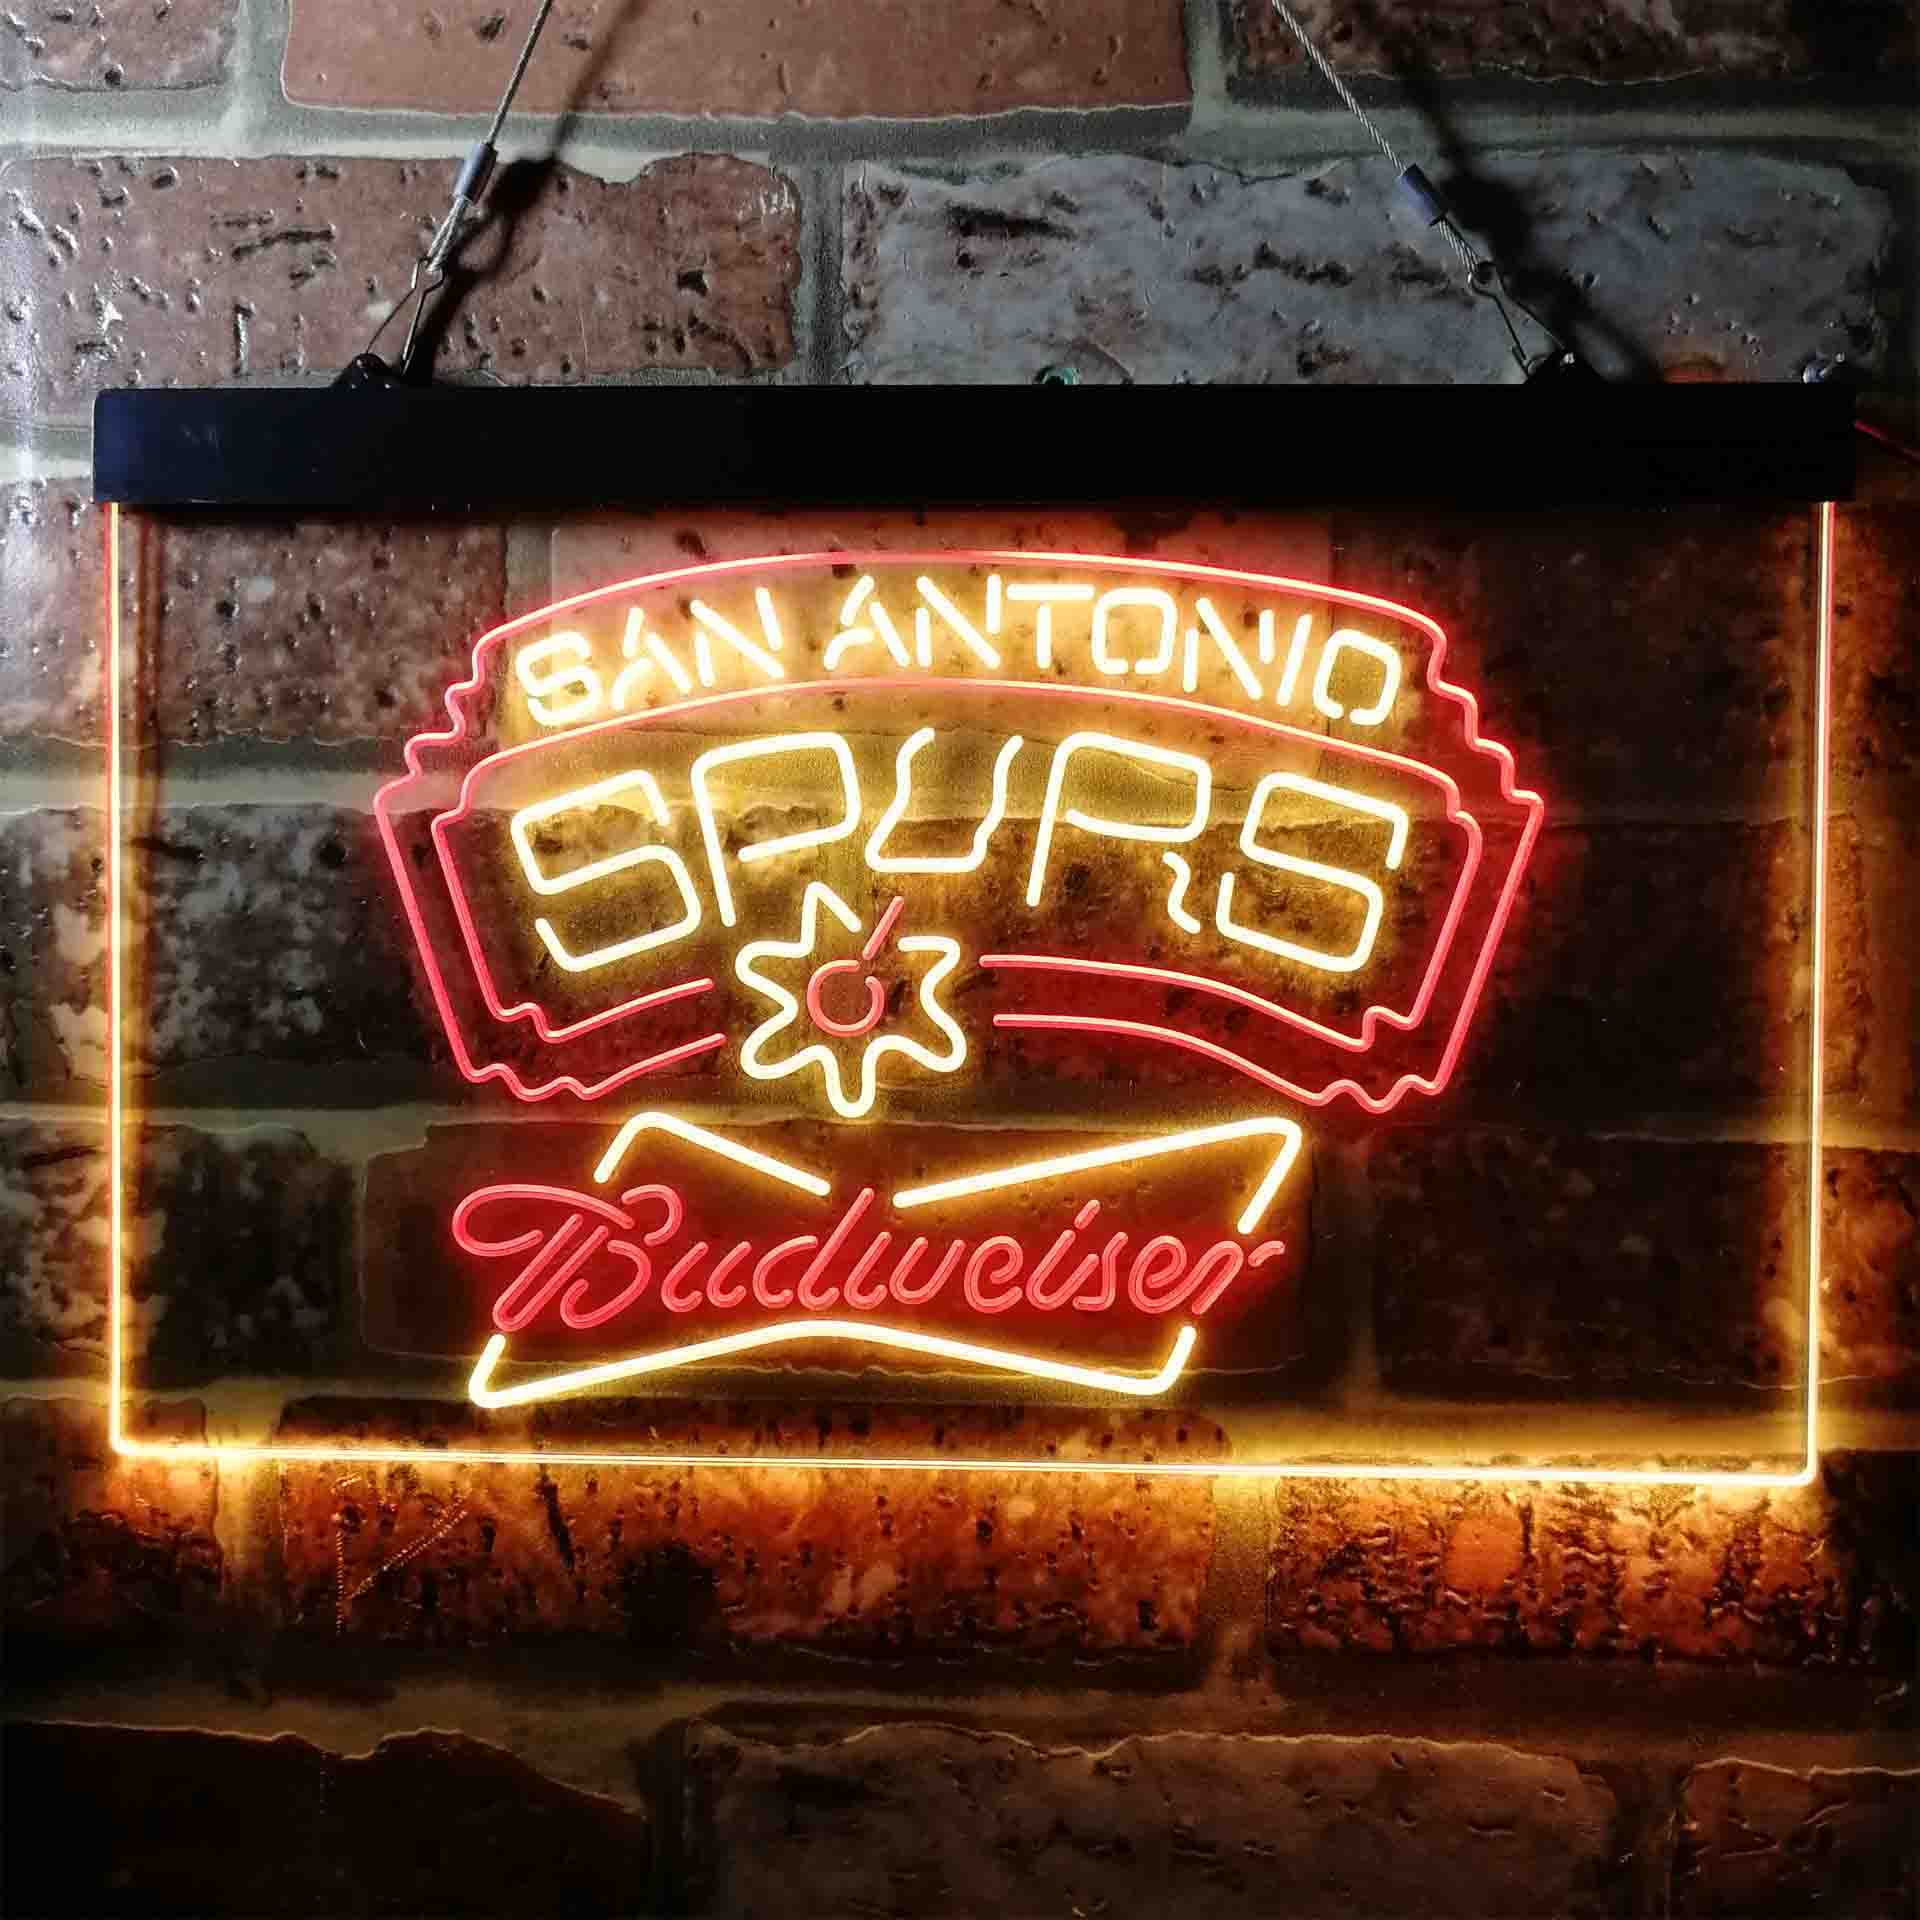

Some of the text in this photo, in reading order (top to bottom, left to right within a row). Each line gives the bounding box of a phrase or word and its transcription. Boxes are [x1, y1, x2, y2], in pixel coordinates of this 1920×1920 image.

[514, 574, 1403, 728] SAN ANTONIO
[509, 729, 1412, 974] SPURS
[452, 1184, 1284, 1331] Budweiser
